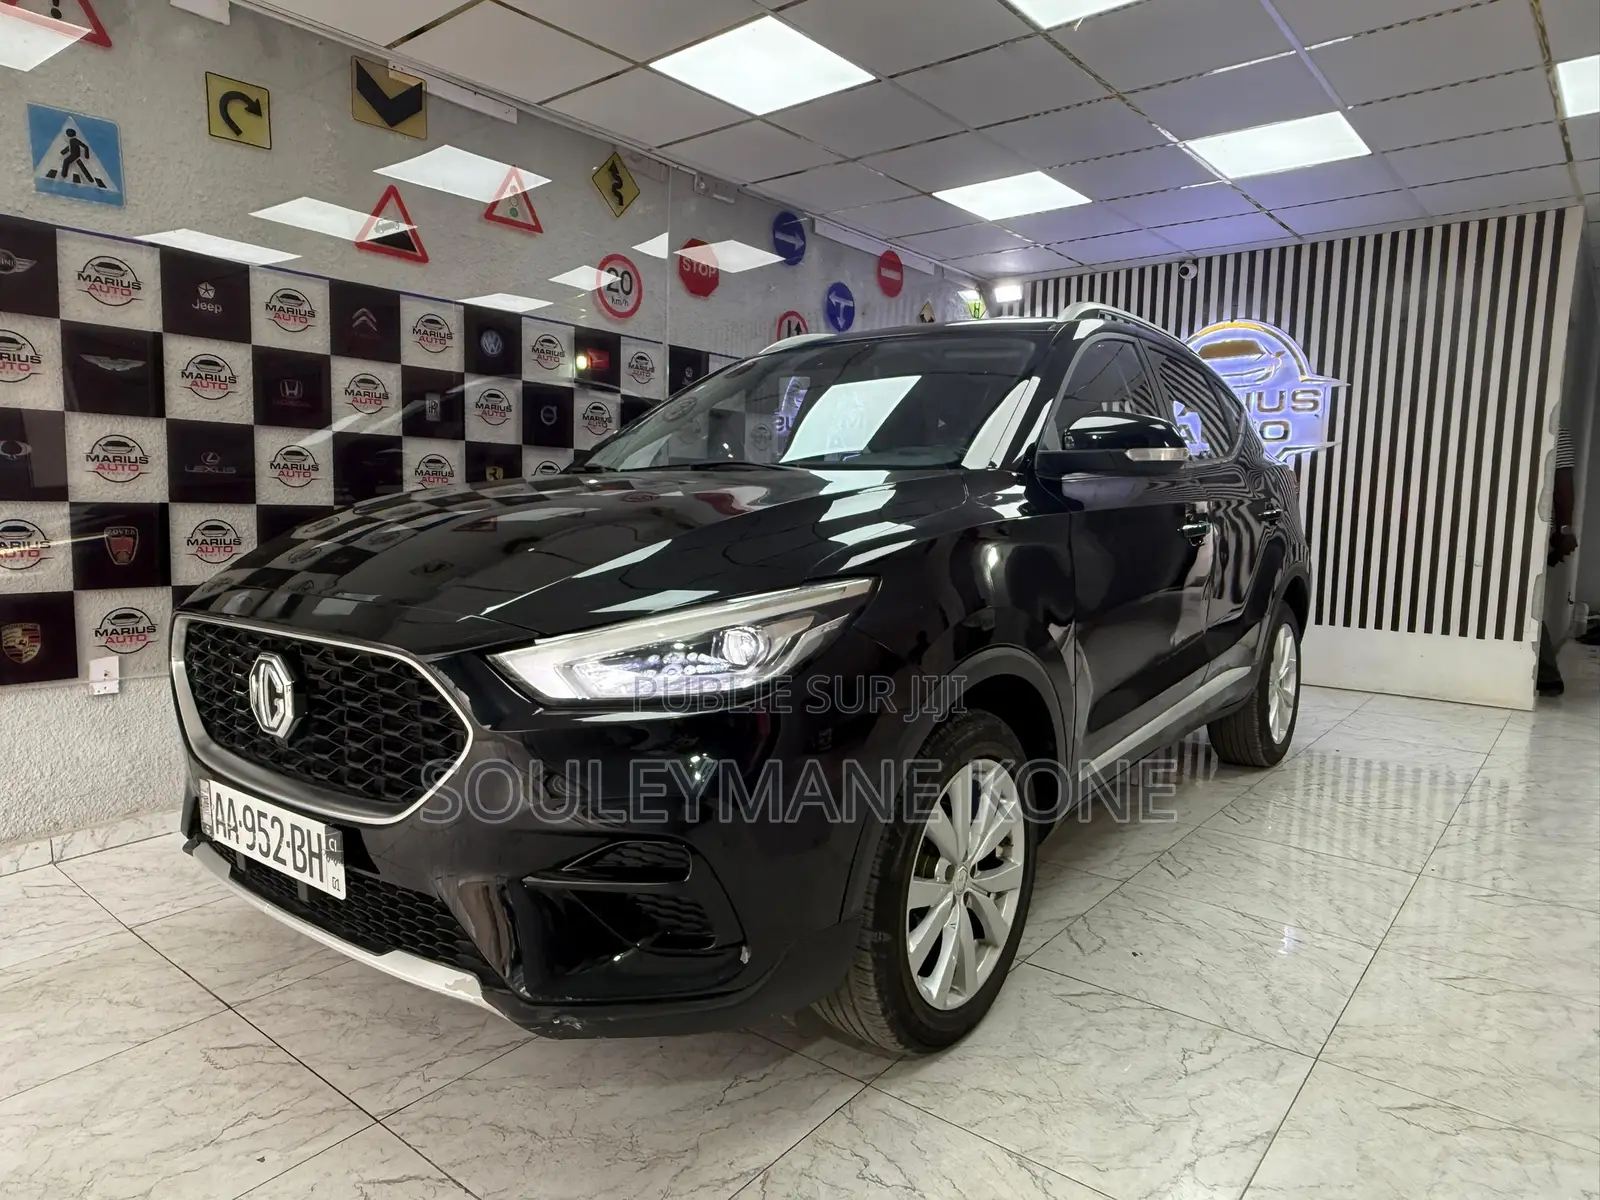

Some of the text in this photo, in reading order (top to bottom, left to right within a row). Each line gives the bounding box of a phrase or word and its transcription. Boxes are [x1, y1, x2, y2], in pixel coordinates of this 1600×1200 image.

[682, 257, 717, 278] STOP
[77, 272, 142, 291] MARIUS
[606, 267, 633, 295] 20
[87, 283, 132, 297] AUTO
[191, 301, 222, 314] Jeep
[265, 303, 316, 318] MARIUS
[273, 312, 308, 324] AUTO
[412, 327, 454, 340] MARIUS
[418, 335, 447, 346] AUTO
[532, 347, 566, 358] MARIUS
[537, 354, 560, 363] AUTO
[181, 371, 237, 385] MARIUS
[189, 379, 229, 391] AUTO
[344, 387, 389, 400] MARIUS
[351, 396, 383, 406] AUTO
[475, 402, 512, 413] MARIUS
[481, 410, 507, 418] AUTO
[86, 454, 149, 465] MARIUS
[95, 463, 140, 472] AUTO
[184, 464, 236, 474] LEXUS
[270, 462, 319, 472] MARIUS
[277, 470, 312, 478] AUTO
[414, 468, 455, 478] MARIUS
[421, 476, 449, 484] AUTO
[186, 537, 242, 547] MARIUS
[195, 545, 233, 554] AUTO
[94, 625, 157, 638] MARIUS
[105, 634, 147, 644] AUTO
